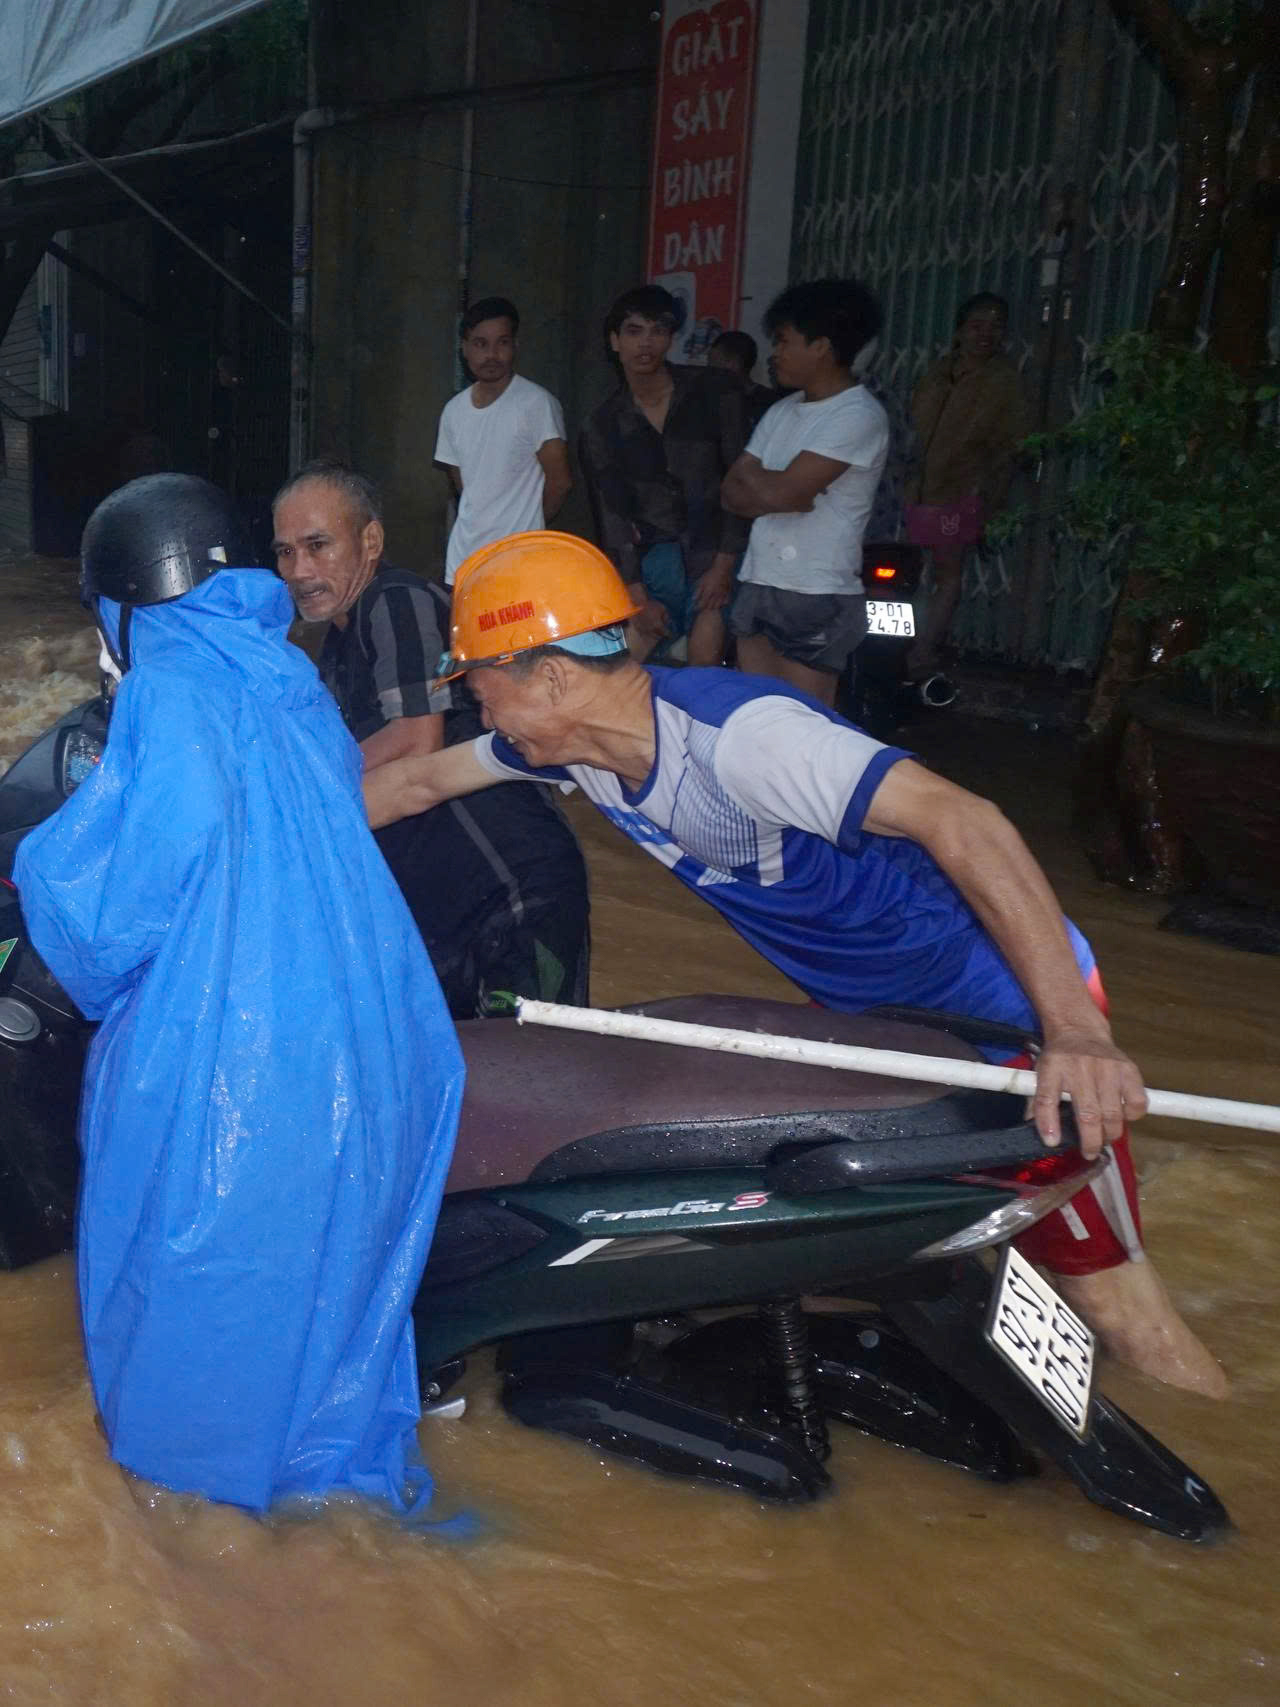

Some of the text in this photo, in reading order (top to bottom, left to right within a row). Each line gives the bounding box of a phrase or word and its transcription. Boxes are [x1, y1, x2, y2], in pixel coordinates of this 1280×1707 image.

[672, 80, 736, 142] SẤY
[663, 156, 735, 209] BÌNH
[663, 220, 725, 271] DÂN
[498, 600, 535, 625] KHÁNH
[867, 601, 903, 618] 3-D1
[867, 617, 912, 635] 24.78
[577, 1199, 727, 1224] FreeGo
[1041, 1301, 1090, 1426] 075.50
